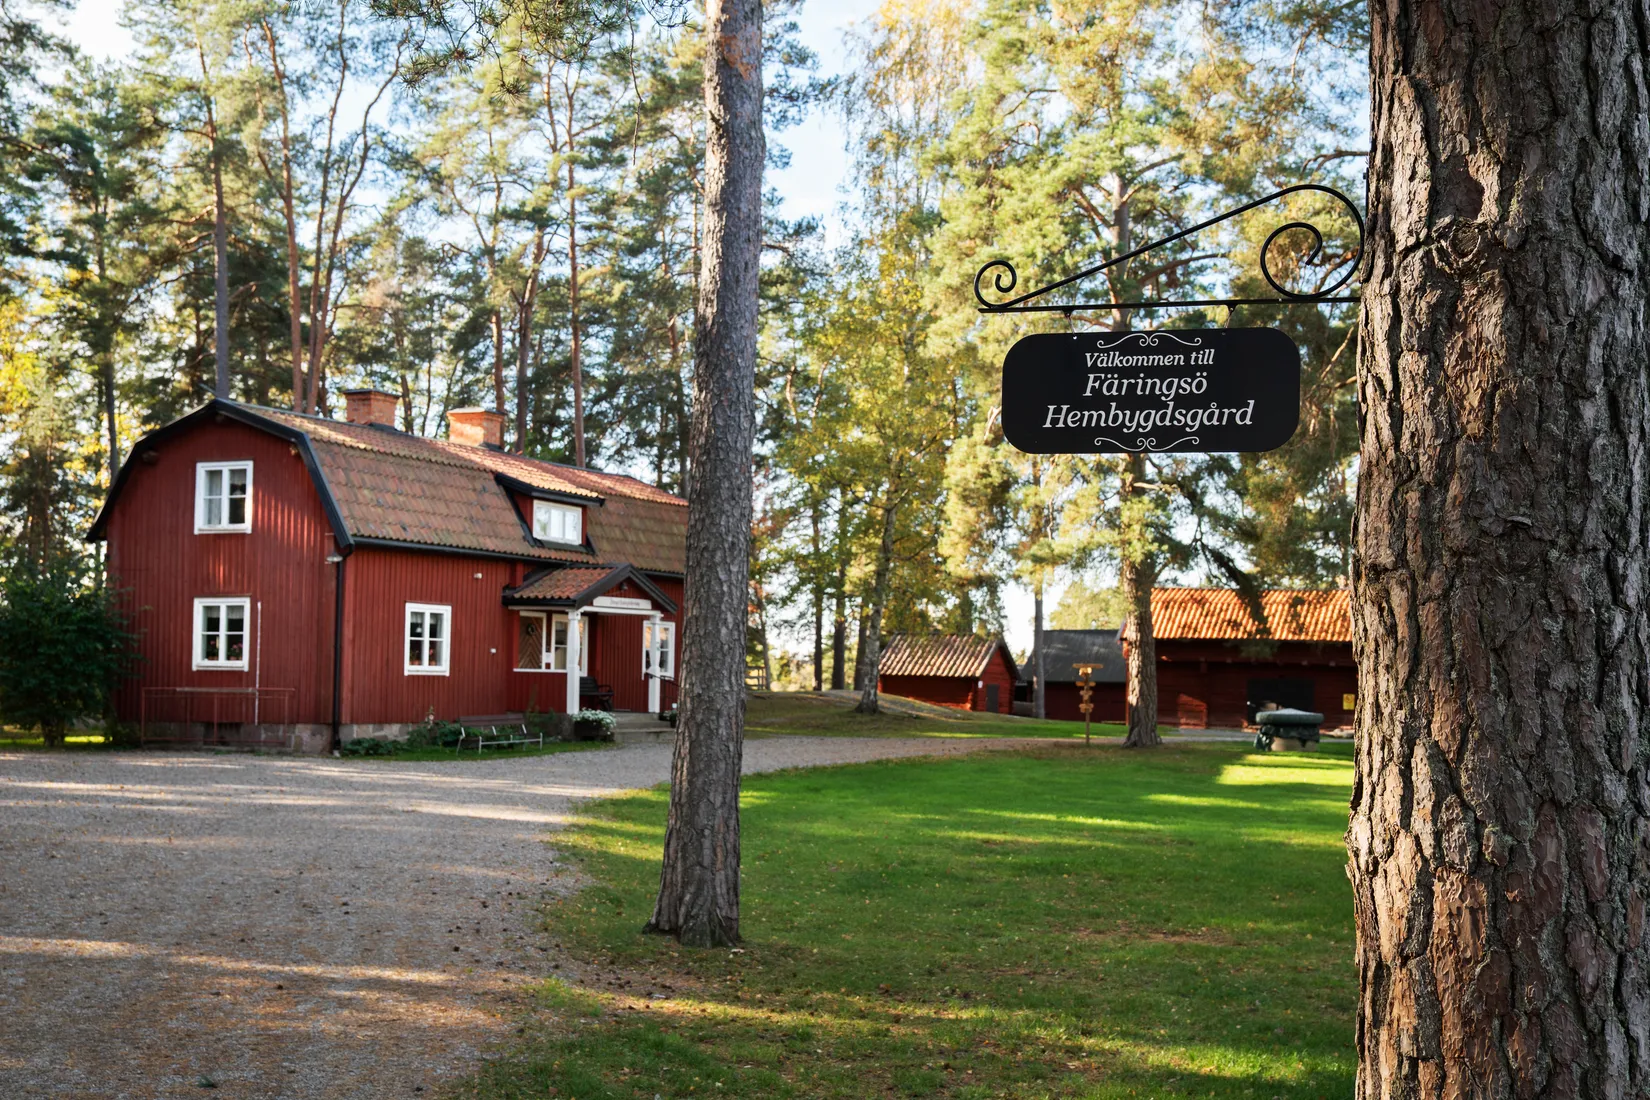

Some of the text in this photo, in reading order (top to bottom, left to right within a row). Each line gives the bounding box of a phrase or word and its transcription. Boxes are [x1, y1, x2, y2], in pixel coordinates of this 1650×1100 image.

[1085, 349, 1214, 368] Välkommen till
[1082, 372, 1208, 401] Färingsö
[1042, 400, 1255, 432] Hembygdsgård
